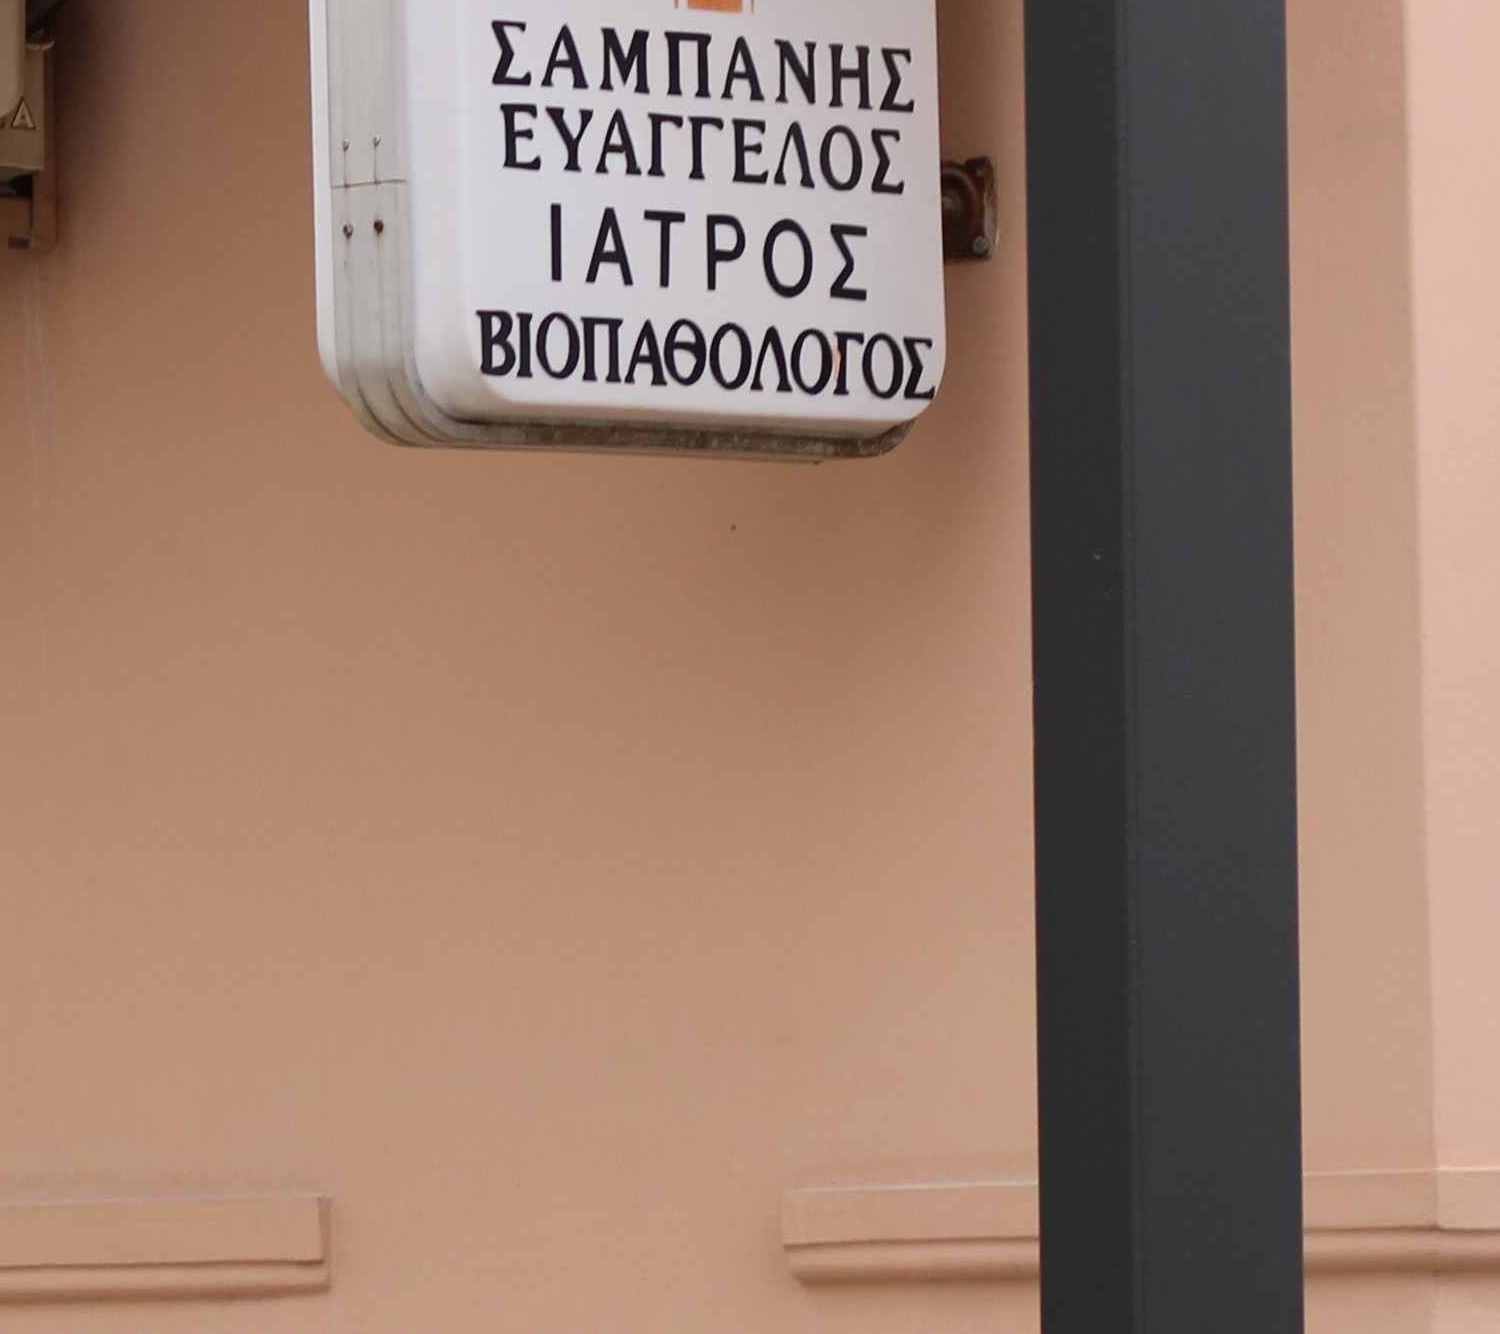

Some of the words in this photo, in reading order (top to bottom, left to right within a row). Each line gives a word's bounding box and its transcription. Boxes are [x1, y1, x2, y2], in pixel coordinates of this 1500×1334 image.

[491, 19, 915, 113] ΣΑΜΠΑΝΗΣ
[500, 103, 905, 195] ΕΥΑΓΓΕΛΟΣ
[549, 202, 869, 302] ΙΑΤΡΟΣ
[476, 309, 935, 401] ΒΙΟΠΑΘΟΛΟΓΟΣ
